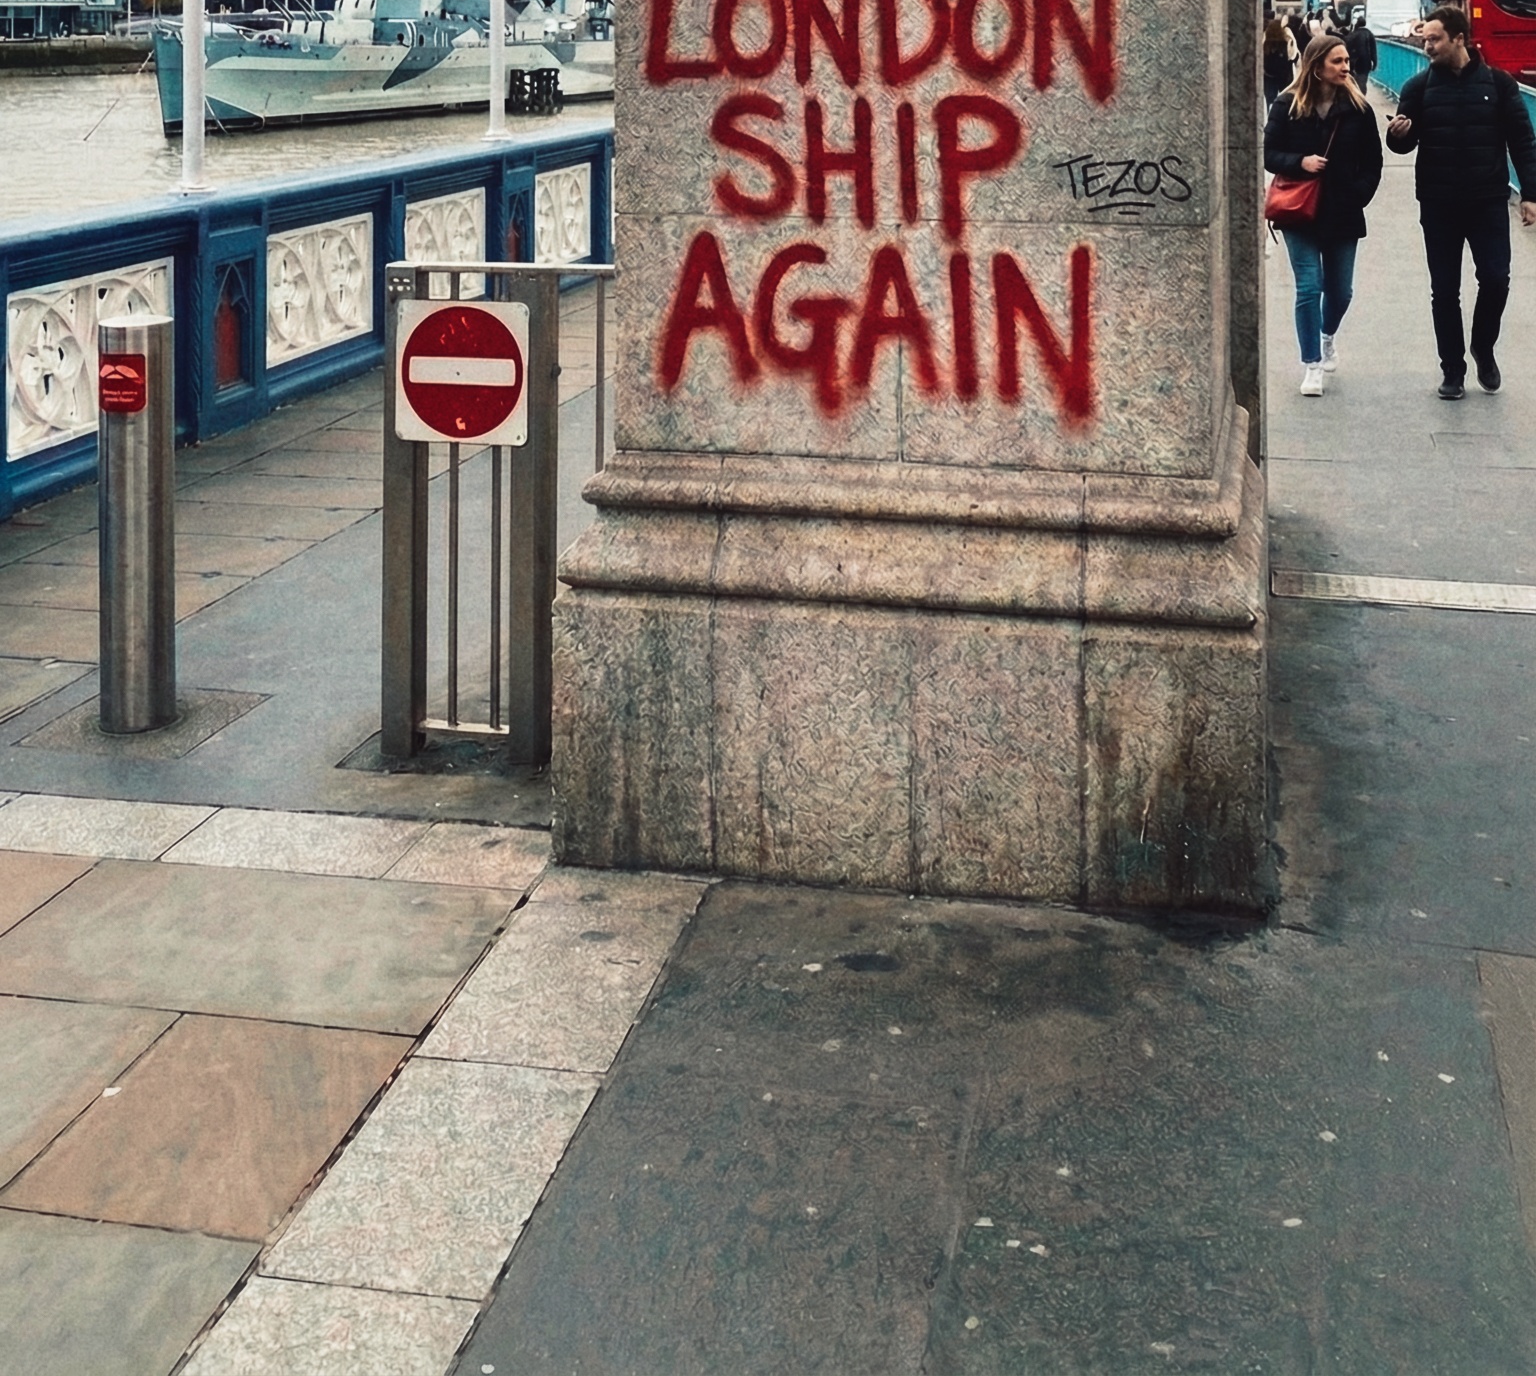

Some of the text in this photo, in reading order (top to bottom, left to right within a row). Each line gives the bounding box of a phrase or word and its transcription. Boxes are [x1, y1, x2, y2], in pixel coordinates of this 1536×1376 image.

[709, 93, 1026, 248] SHIP
[1052, 154, 1192, 202] TEZOS
[658, 230, 1098, 428] AGAIN
